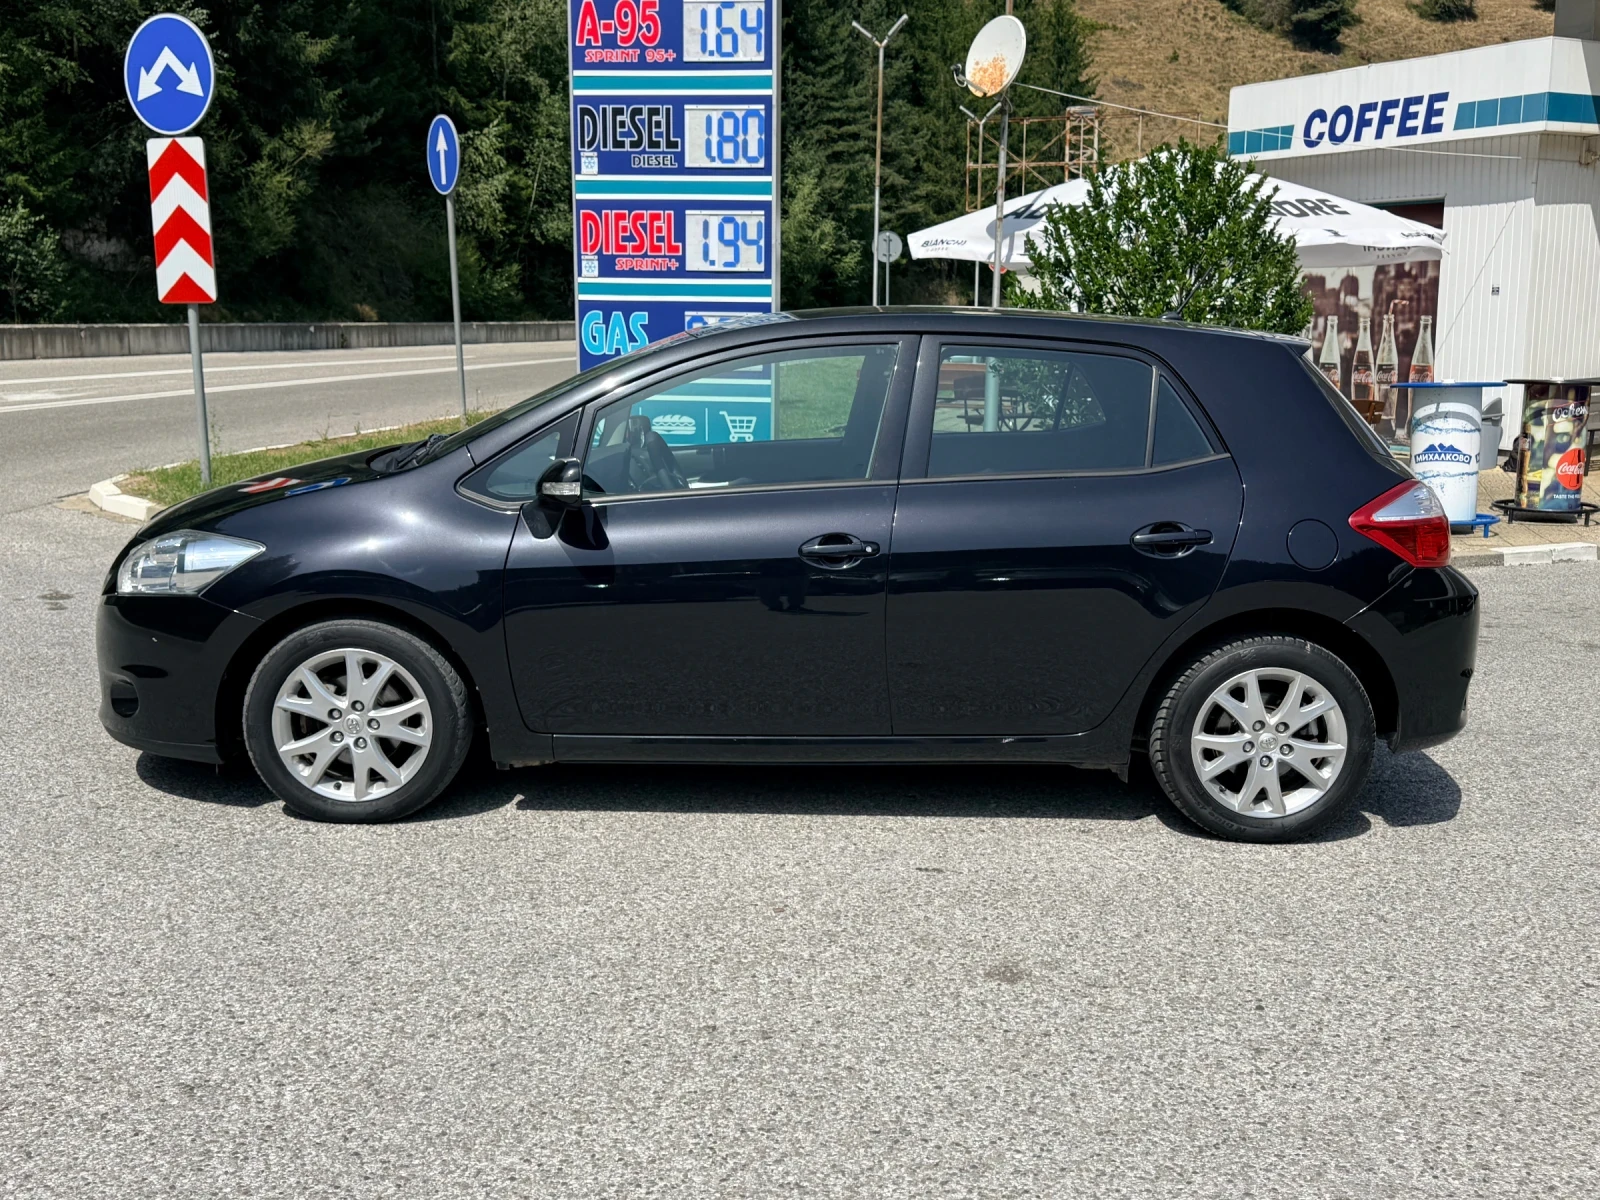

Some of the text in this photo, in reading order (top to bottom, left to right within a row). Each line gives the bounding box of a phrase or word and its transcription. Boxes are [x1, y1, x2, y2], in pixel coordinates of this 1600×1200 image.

[576, 0, 661, 46] A-95
[701, 2, 763, 57] 1.64
[585, 49, 676, 62] SPRINT 95+
[577, 105, 681, 151] DIESEL
[705, 110, 765, 164] 1.80
[1303, 92, 1449, 148] COFFEE
[631, 154, 678, 168] DIESEL
[579, 210, 682, 255] DIESEL
[702, 216, 763, 268] 1.94
[615, 258, 679, 270] SPRINT+
[581, 310, 649, 355] GAS
[1416, 453, 1470, 462] МИХАЛКОВО
